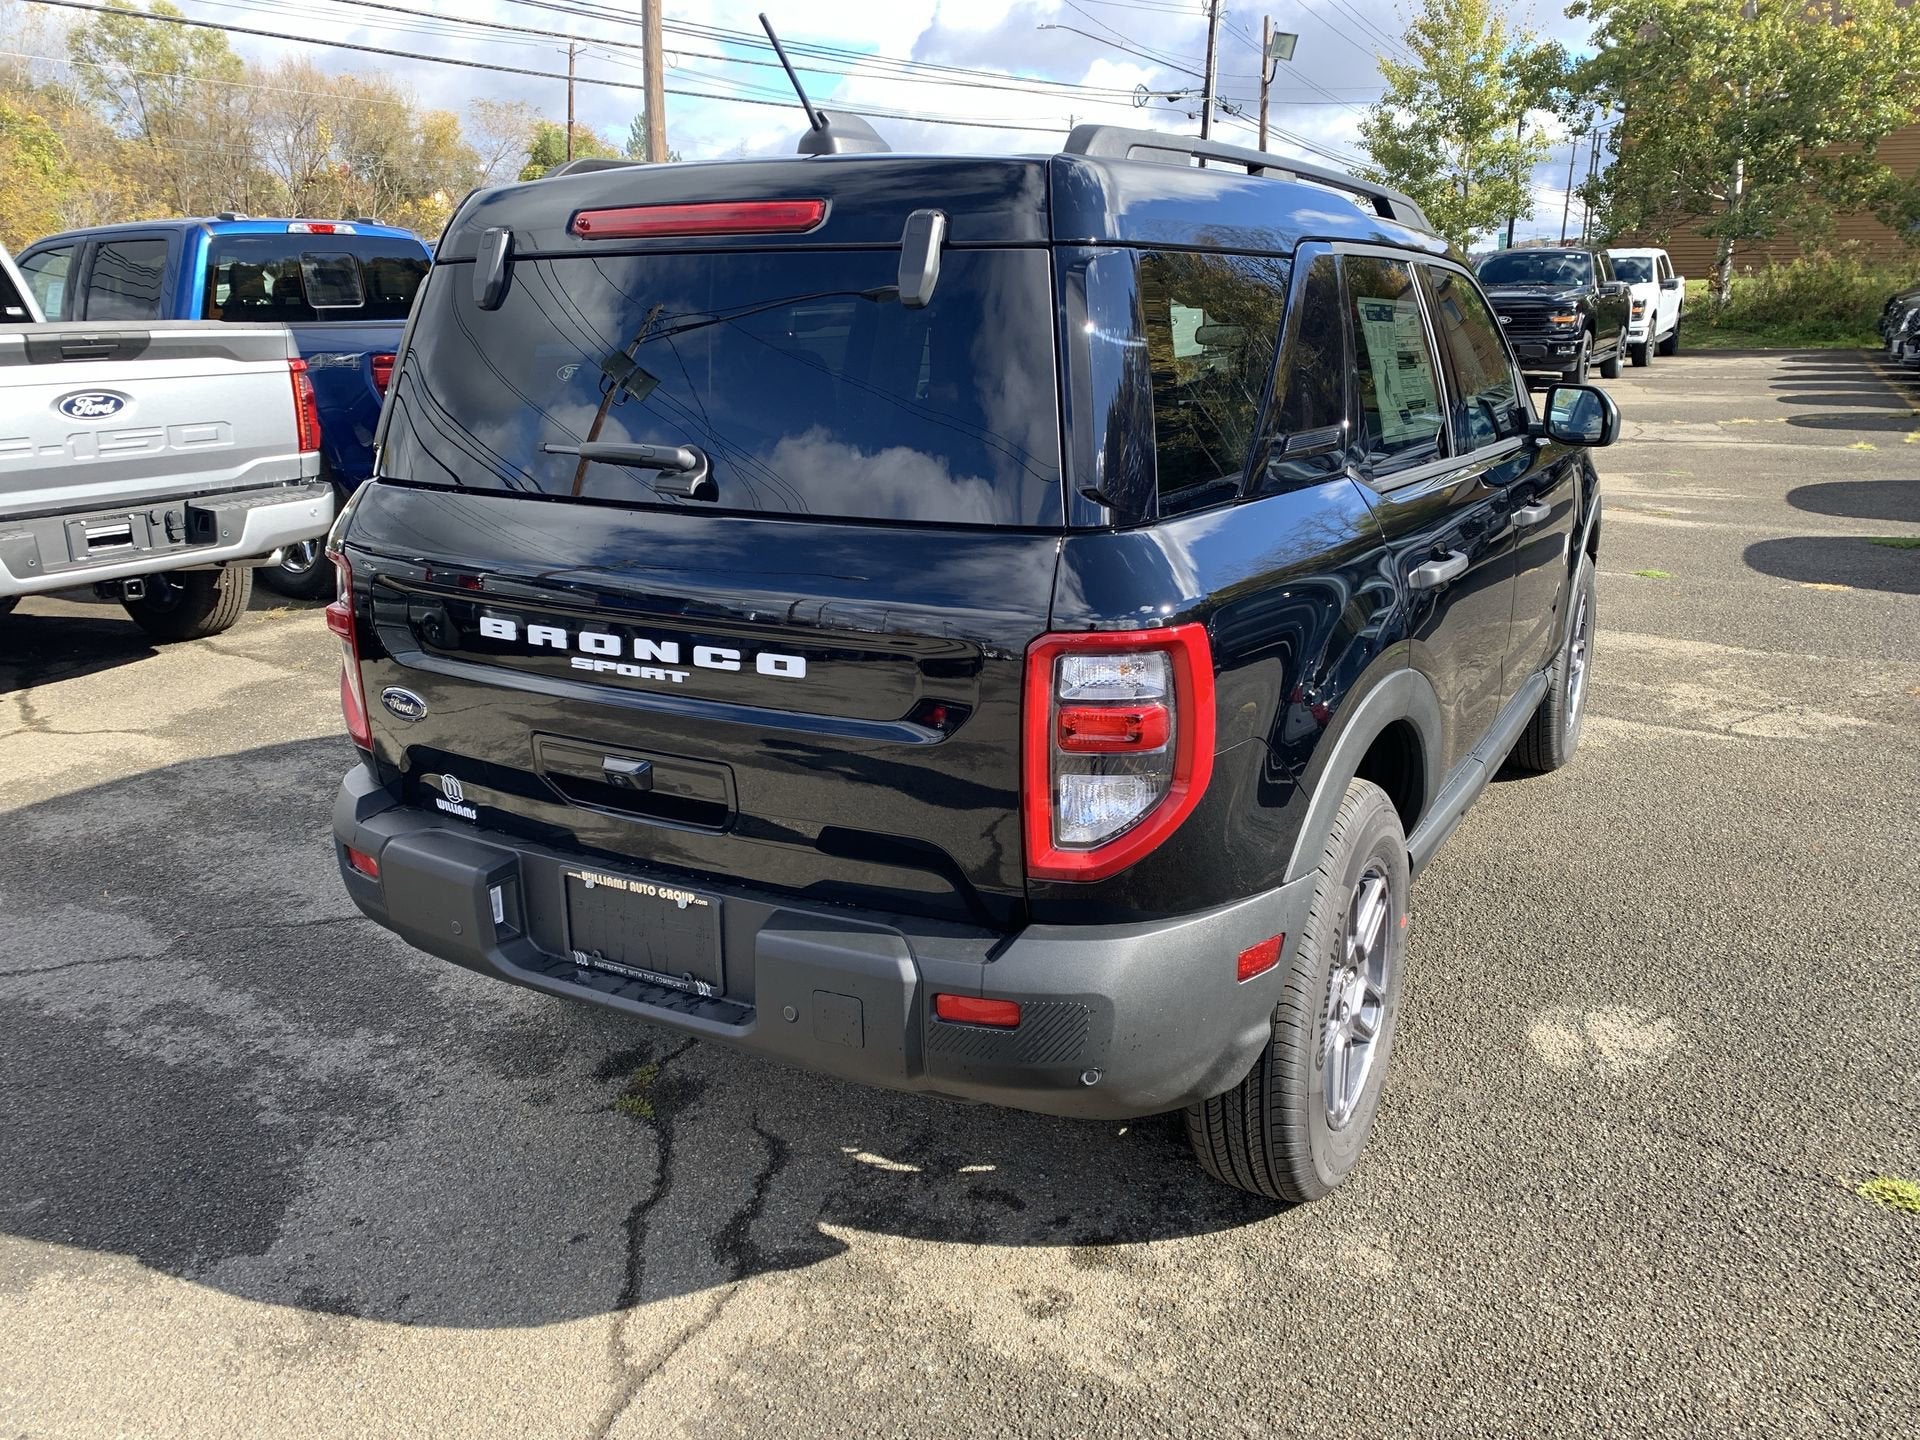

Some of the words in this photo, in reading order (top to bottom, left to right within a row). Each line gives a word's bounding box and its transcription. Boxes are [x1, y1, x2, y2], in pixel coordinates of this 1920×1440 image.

[71, 395, 116, 416] Ford
[479, 616, 806, 679] BRONCO
[570, 656, 690, 683] SPORT
[436, 798, 477, 820] WILLIAMS
[629, 881, 656, 896] AUTO
[594, 961, 627, 975] PARTNERING
[628, 969, 643, 979] WITH
[643, 973, 655, 981] THE
[1315, 926, 1342, 1072] Continental
